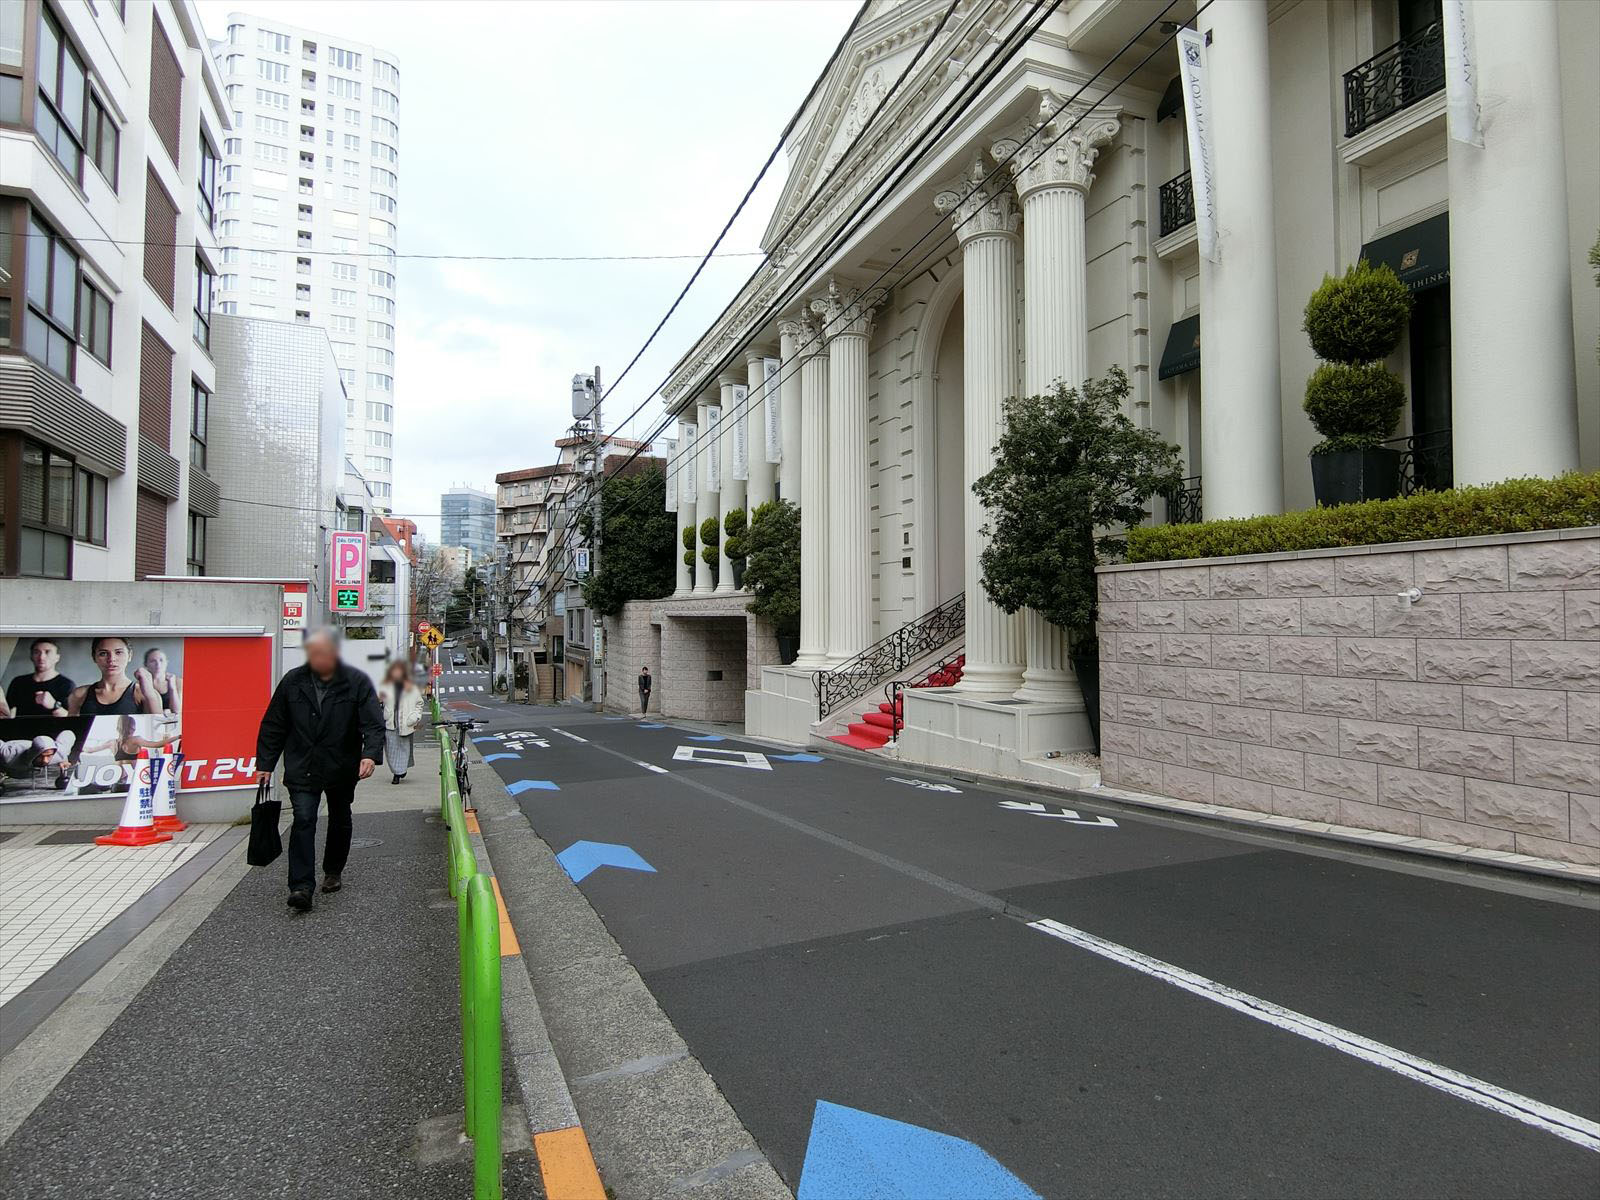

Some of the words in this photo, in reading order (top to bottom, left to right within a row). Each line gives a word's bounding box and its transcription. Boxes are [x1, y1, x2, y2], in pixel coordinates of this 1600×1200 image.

[340, 544, 360, 579] P
[338, 590, 360, 609] 空
[212, 757, 257, 780] 24
